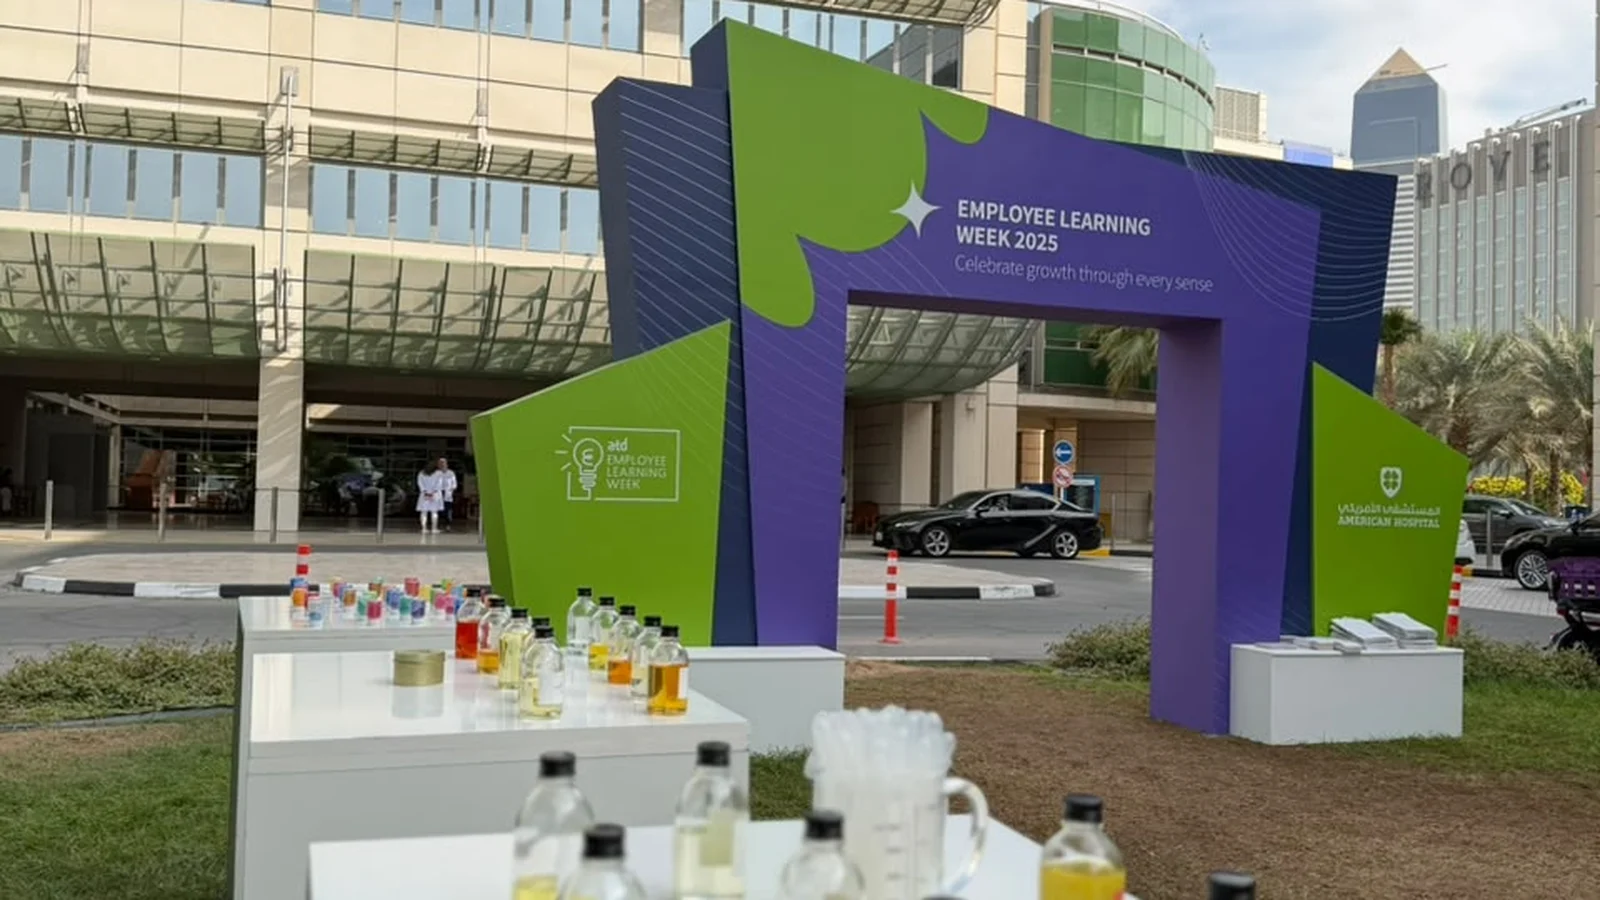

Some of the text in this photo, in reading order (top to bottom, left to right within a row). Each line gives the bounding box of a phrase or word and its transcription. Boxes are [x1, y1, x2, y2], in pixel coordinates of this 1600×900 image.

[1415, 140, 1551, 200] ROVE
[957, 199, 1151, 236] EMPLOYEE LEARNING
[956, 225, 1059, 252] WEEK 2025
[954, 253, 1214, 293] Celebrate growth through every sense
[607, 437, 629, 452] atd
[607, 454, 667, 467] EMPLOYEE
[606, 466, 667, 479] LEARNING
[606, 478, 641, 490] WEEK
[1337, 516, 1440, 529] AMERICAN HOSPITAL
